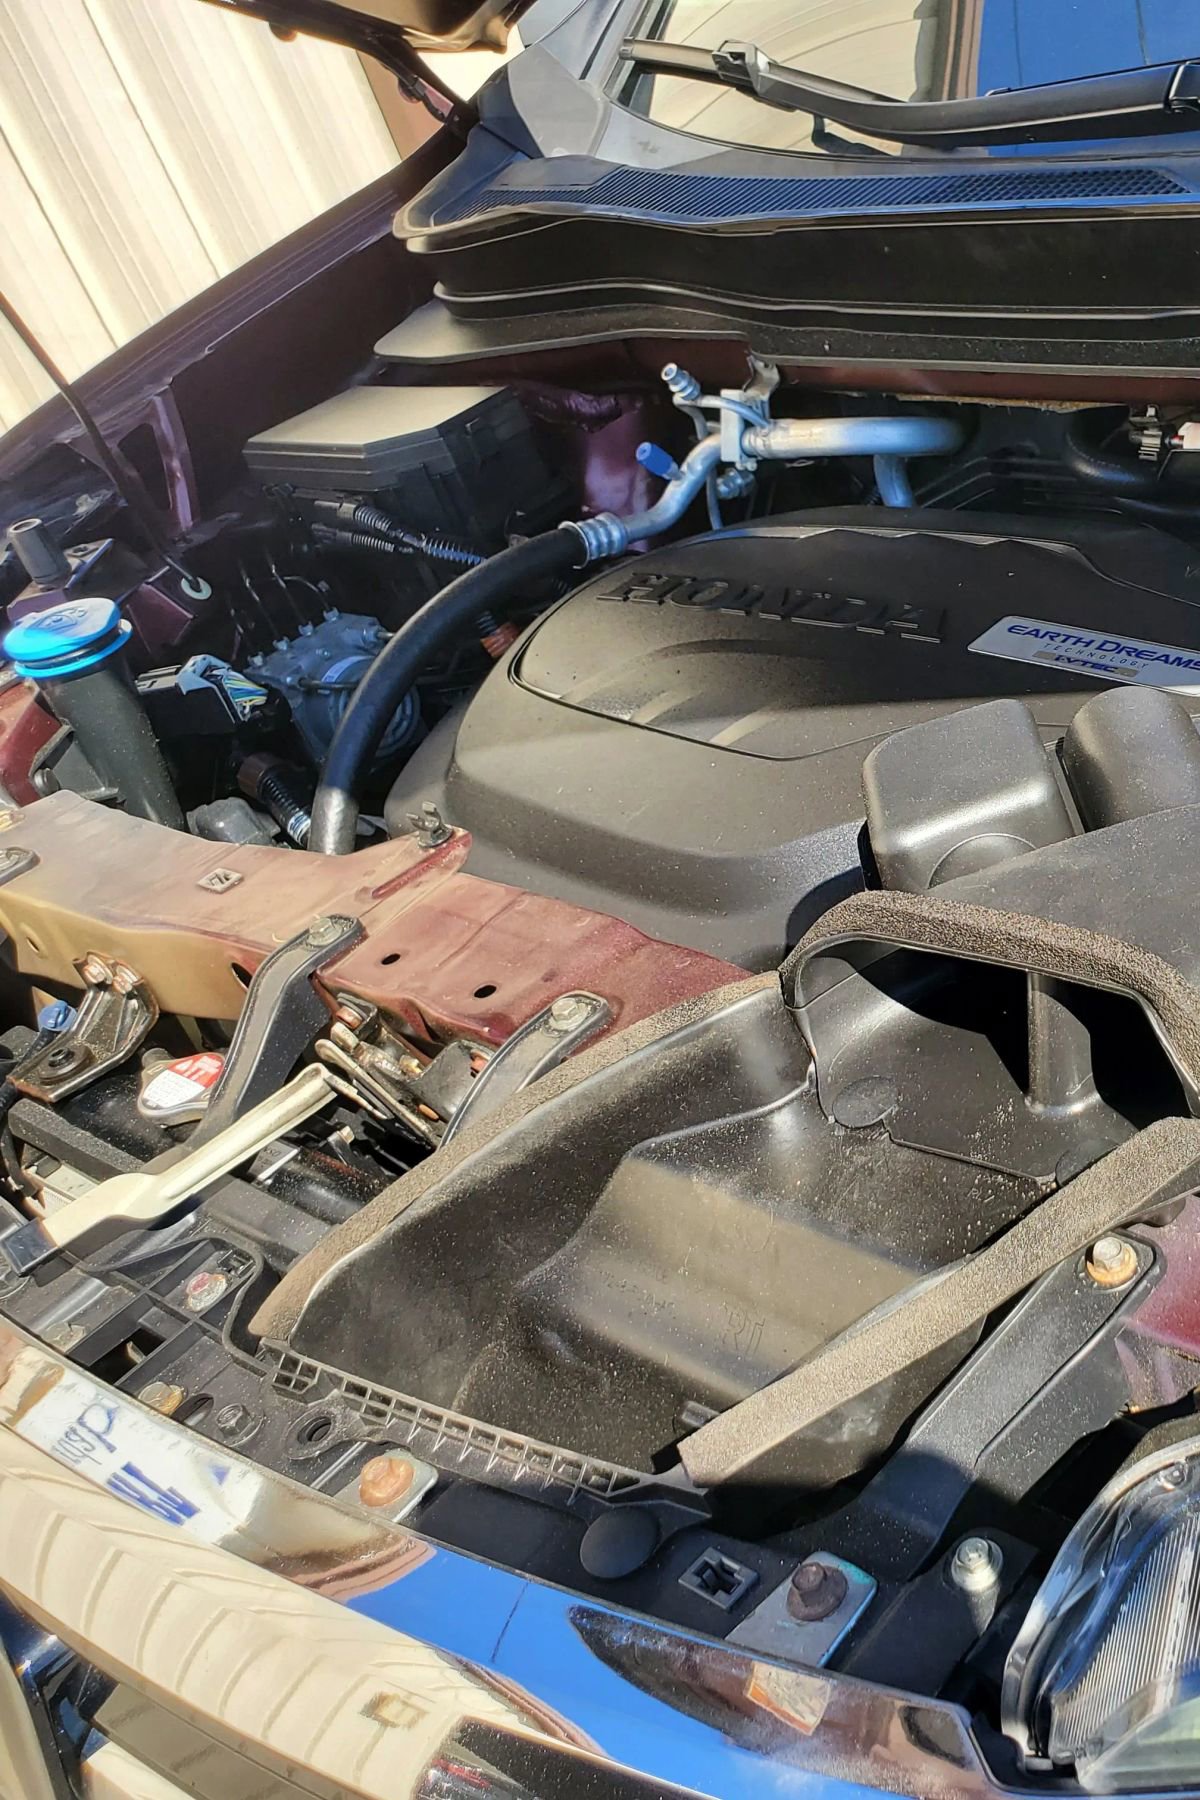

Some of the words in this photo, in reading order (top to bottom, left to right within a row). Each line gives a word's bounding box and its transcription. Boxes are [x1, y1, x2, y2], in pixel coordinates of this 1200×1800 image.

[596, 572, 941, 643] HONDA
[1007, 624, 1095, 648] EARTH
[1044, 643, 1149, 669] TECHNOLOGY
